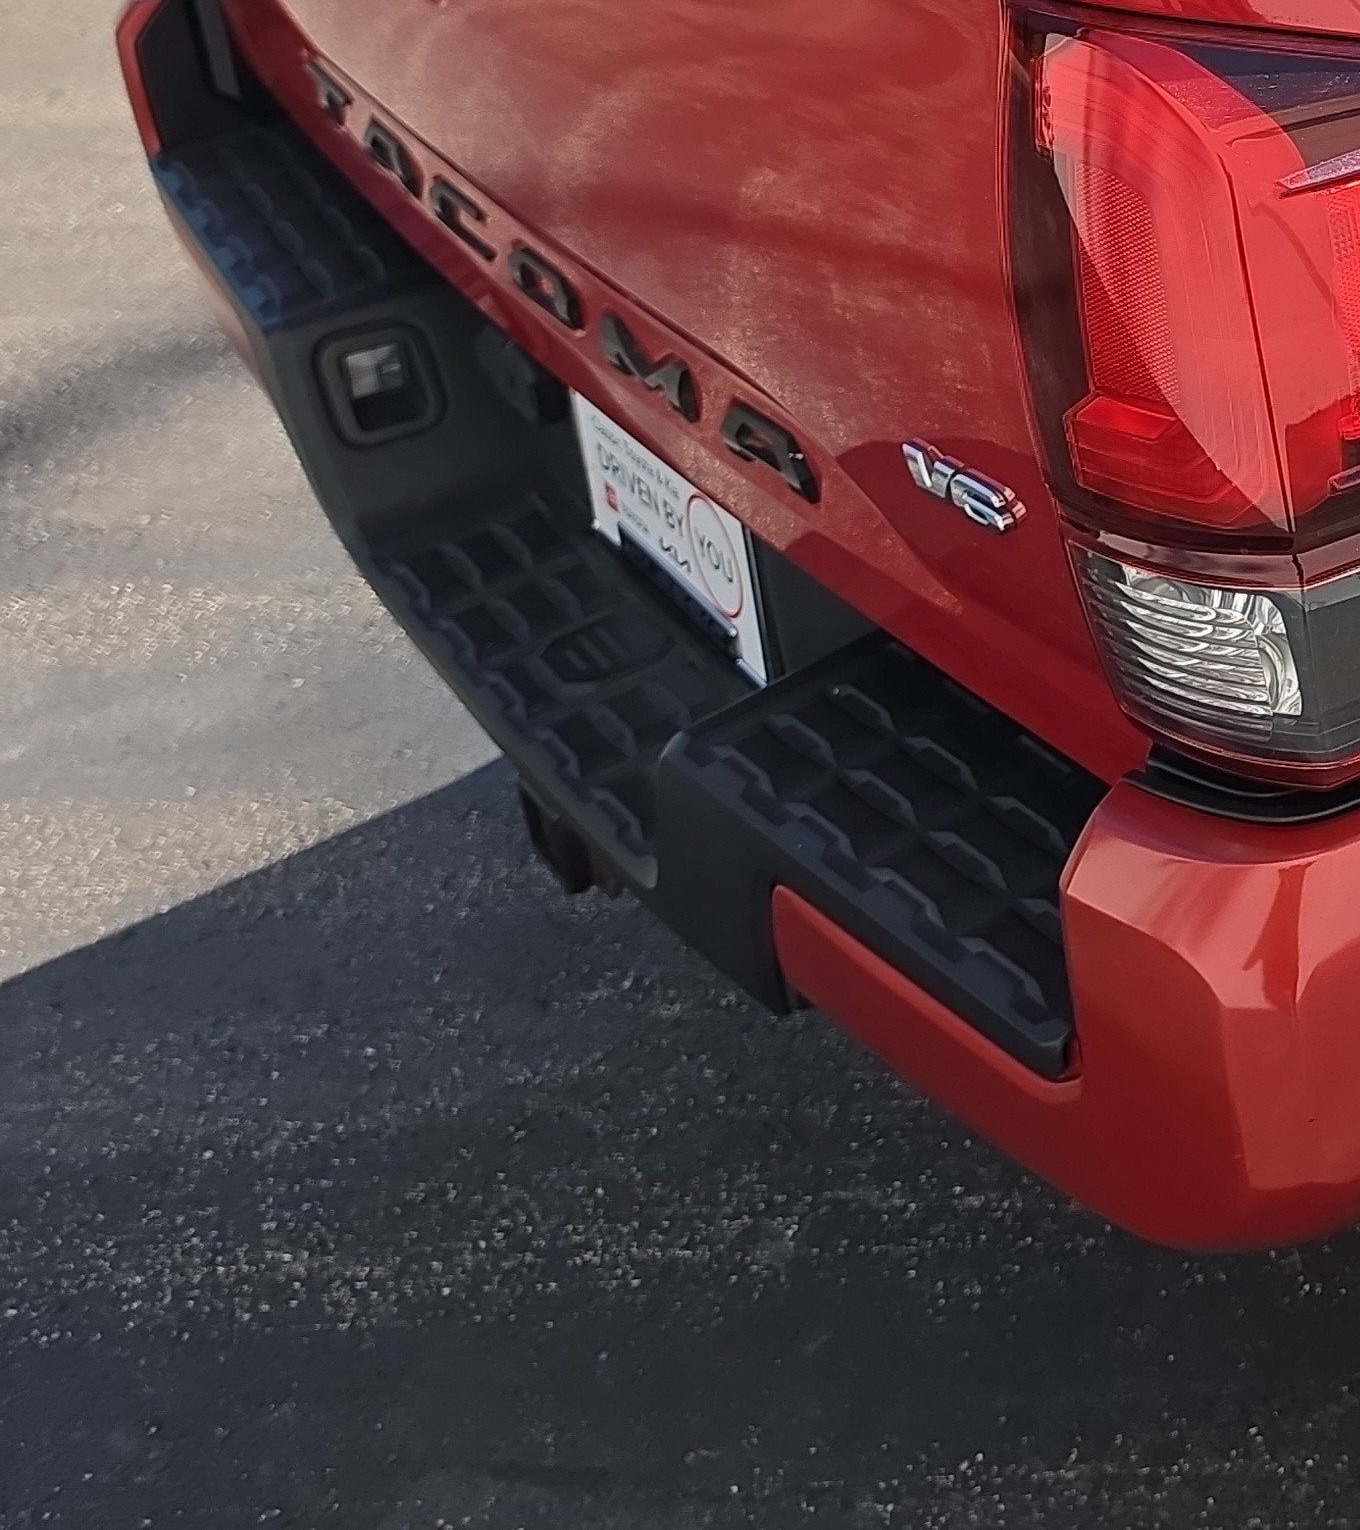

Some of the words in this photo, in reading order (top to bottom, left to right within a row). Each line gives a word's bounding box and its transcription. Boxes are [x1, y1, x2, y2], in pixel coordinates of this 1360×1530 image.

[302, 50, 822, 504] TACOMA
[597, 442, 661, 517] DRIVEN
[663, 498, 685, 537] BY
[901, 442, 1018, 532] V6
[696, 529, 735, 583] YOU
